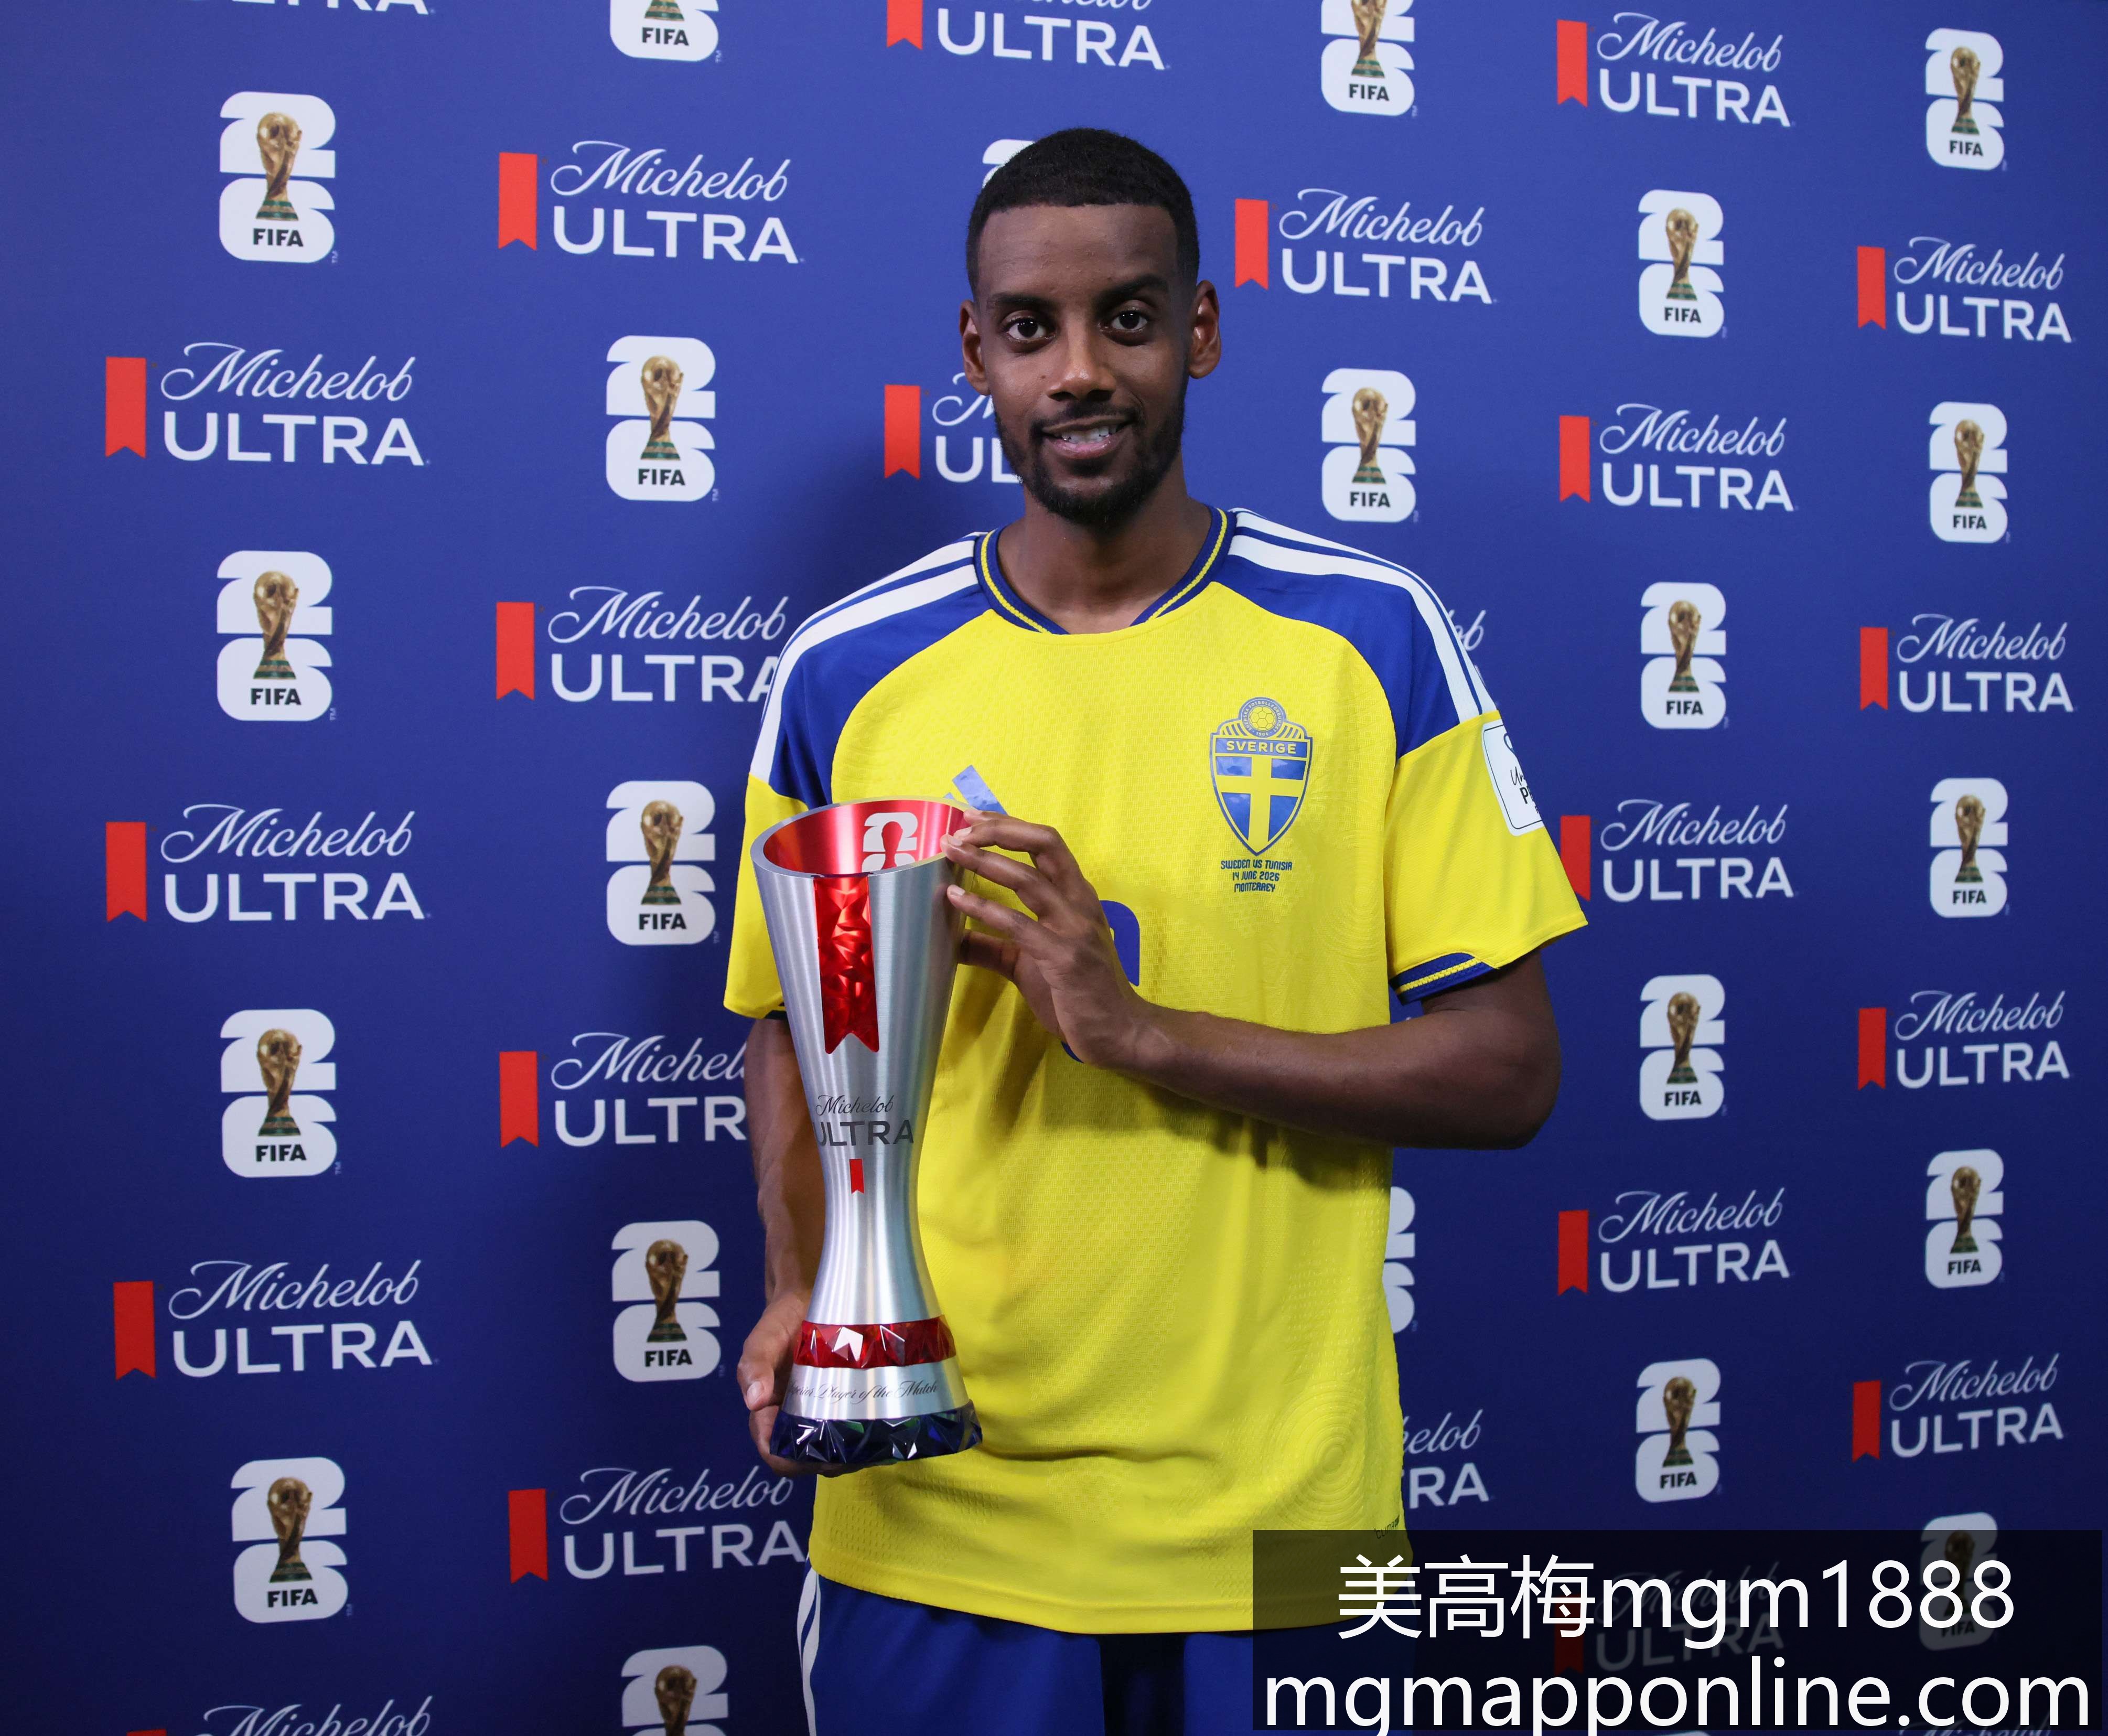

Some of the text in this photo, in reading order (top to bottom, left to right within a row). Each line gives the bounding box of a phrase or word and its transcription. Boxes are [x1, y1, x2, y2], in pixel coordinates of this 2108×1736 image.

[642, 27, 689, 46] FIFA
[938, 8, 1165, 70] ULTRA
[1597, 12, 1783, 71] Michelob
[1350, 84, 1389, 101] FIFA
[1600, 68, 1790, 127] ULTRA
[551, 141, 790, 201] Michelob
[1950, 141, 1983, 156] FIFA
[254, 229, 303, 247] FIFA
[554, 206, 798, 263] ULTRA
[1279, 188, 1485, 246] Michelob
[1282, 249, 1492, 304] ULTRA
[1894, 237, 2064, 290] Michelob
[1665, 307, 1701, 323] FIFA
[1897, 292, 2072, 342] ULTRA
[161, 342, 415, 401] Michelob
[164, 411, 424, 466] ULTRA
[1600, 403, 1786, 456] Michelob
[639, 469, 685, 485] FIFA
[1350, 492, 1390, 507] FIFA
[1602, 463, 1793, 511] ULTRA
[1953, 515, 1986, 529] FIFA
[548, 586, 788, 643] Michelob
[1897, 614, 2067, 662] Michelob
[251, 689, 301, 705] FIFA
[1666, 701, 1703, 714] FIFA
[1899, 671, 2073, 712] ULTRA
[1226, 741, 1296, 754] SVERIGE
[161, 804, 414, 863] Michelob
[1600, 799, 1788, 851] Michelob
[1221, 859, 1251, 870] SWEDEN
[1265, 860, 1293, 871] TUNISIA
[1232, 871, 1280, 882] 14 JUNE 2026
[1234, 882, 1275, 893] MONTERREY
[1604, 857, 1793, 902] ULTRA
[165, 873, 425, 923] ULTRA
[639, 913, 686, 929] FIFA
[1953, 891, 1986, 904] FIFA
[1895, 991, 2065, 1040] Michelob
[551, 1032, 747, 1090] Michel
[1897, 1041, 2070, 1088] ULTRA
[555, 1096, 746, 1146] ULTR
[815, 1095, 895, 1116] Michelob
[1665, 1091, 1701, 1106] FIFA
[256, 1144, 306, 1162] FIFA
[813, 1119, 914, 1146] ULTRA
[1599, 1187, 1784, 1242] Michelob
[169, 1260, 421, 1319] Michelob
[1601, 1240, 1790, 1293] ULTRA
[1948, 1260, 1981, 1274] FIFA
[173, 1321, 432, 1377] ULTRA
[646, 1349, 692, 1367] FIFA
[813, 1383, 856, 1404] Player
[851, 1385, 881, 1405] of
[873, 1385, 891, 1399] the
[894, 1380, 938, 1398] Match
[1890, 1354, 2059, 1411] Michelob
[1891, 1403, 2063, 1458] ULTRA
[1660, 1472, 1696, 1488] FIFA
[564, 1521, 805, 1579] ULTRA
[268, 1589, 318, 1608] FIFA
